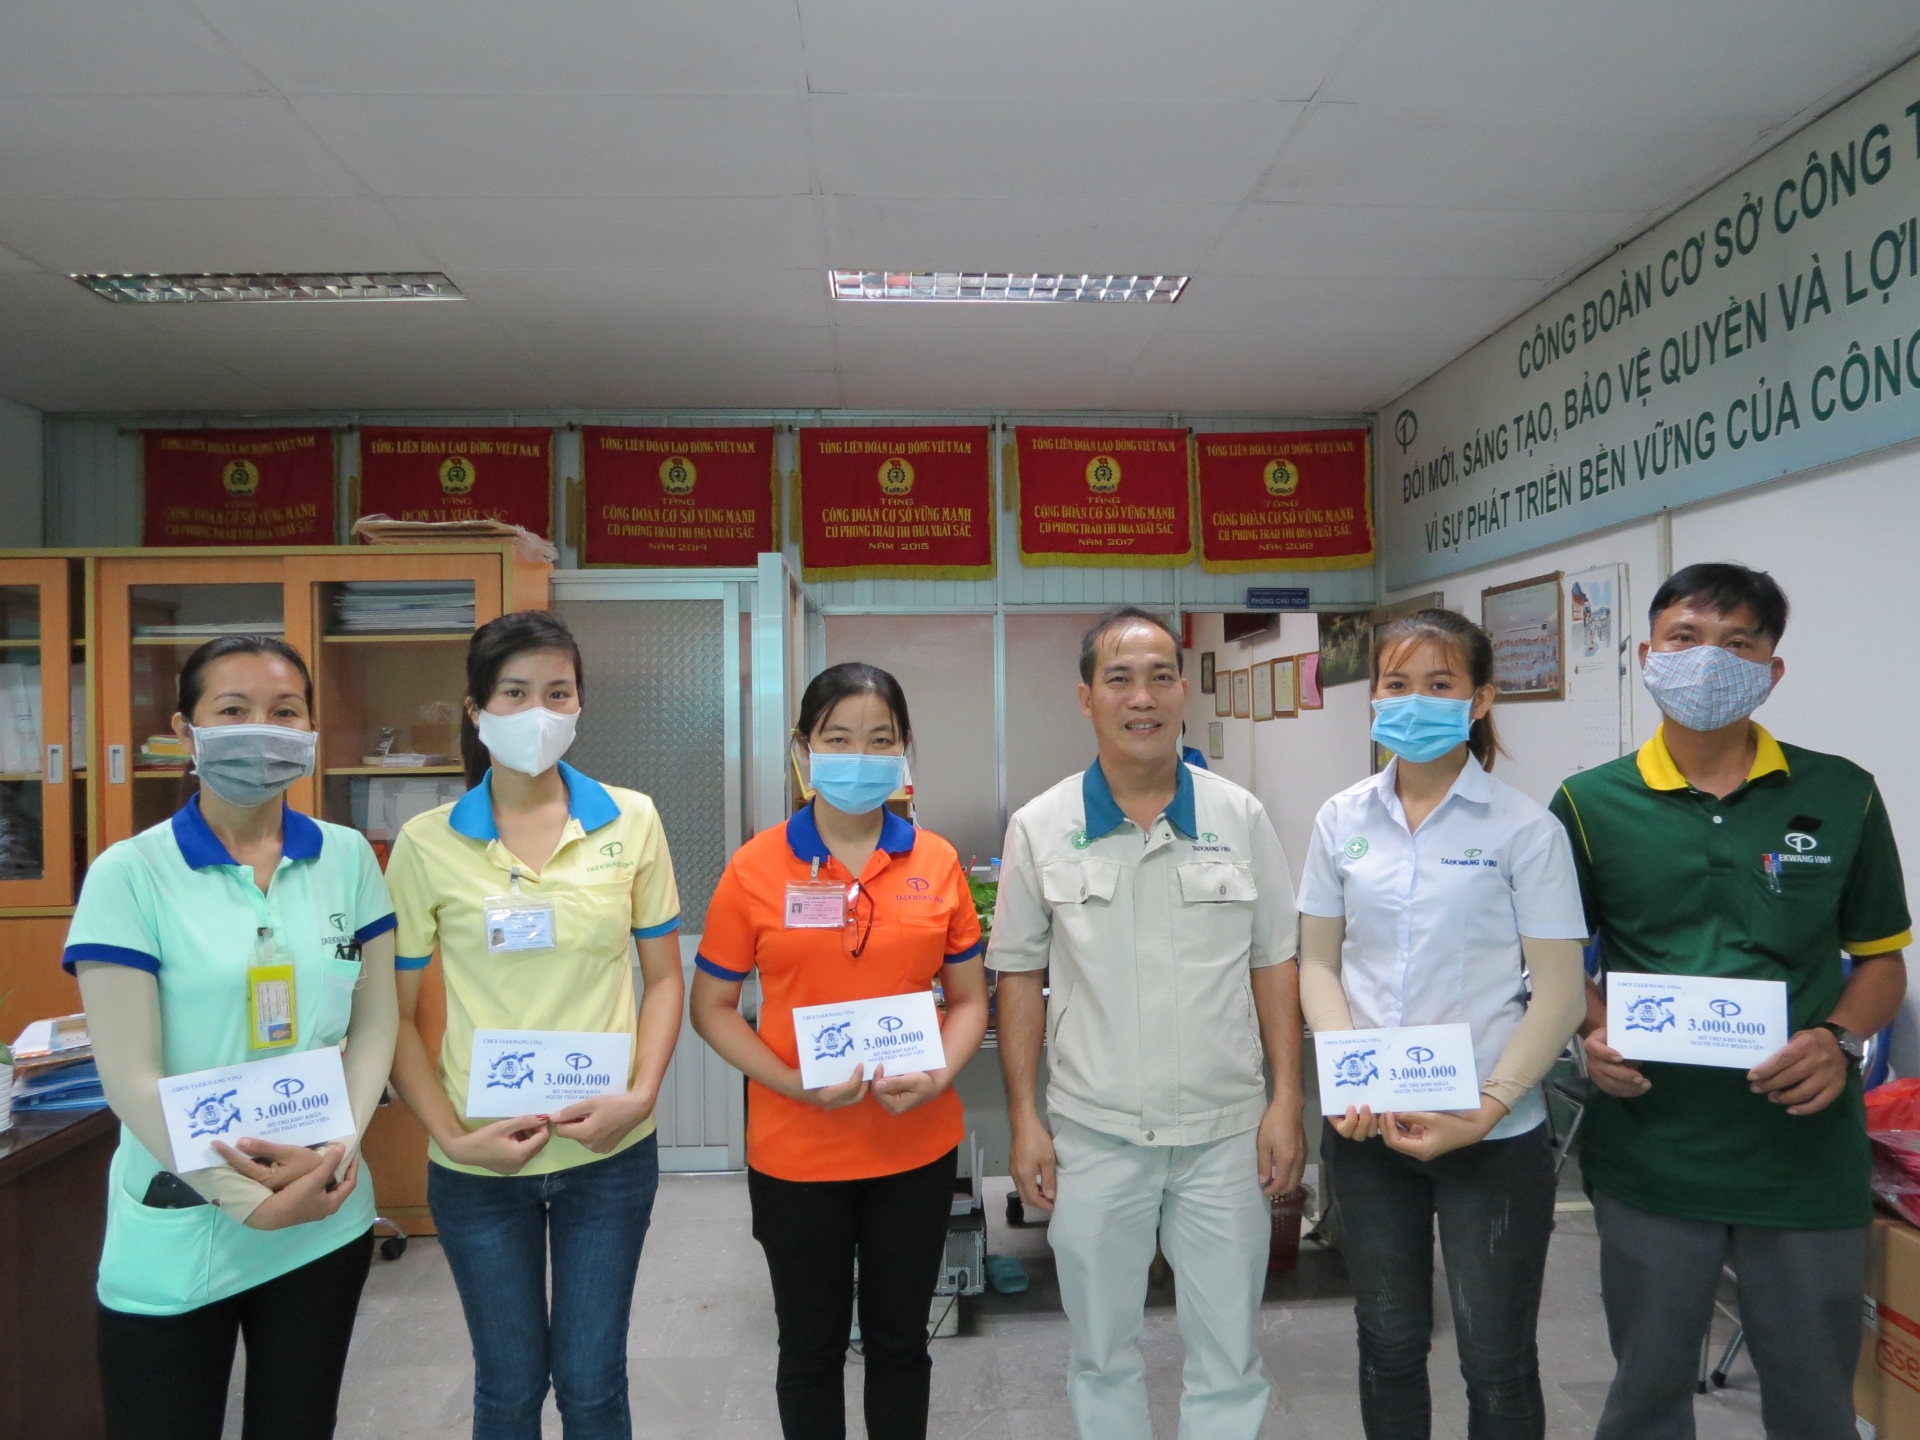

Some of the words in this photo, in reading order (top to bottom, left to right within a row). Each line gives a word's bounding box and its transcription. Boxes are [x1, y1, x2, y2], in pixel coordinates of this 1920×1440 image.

[1518, 313, 1576, 379] CÔNG
[1582, 264, 1651, 344] ĐOÀN
[1661, 231, 1705, 297] CƠ
[1714, 191, 1762, 268] SỞ
[1774, 123, 1891, 234] CÔNG
[1428, 445, 1458, 493] MỚI,
[1463, 428, 1507, 476] SÁNG
[1513, 401, 1557, 457] TẠO,
[1564, 371, 1612, 431] BẢO
[1618, 346, 1651, 407] VỆ
[1660, 292, 1767, 385] QUYỀN
[1777, 252, 1831, 332] VÀ
[1845, 216, 1918, 306] LỢI
[736, 441, 755, 453] NAM
[953, 441, 971, 454] NAM
[1158, 441, 1175, 452] NAM
[1425, 511, 1438, 553] VÌ
[1442, 510, 1463, 553] SỰ
[1467, 487, 1510, 540] PHÁT
[1515, 463, 1571, 523] TRIỂN
[1579, 443, 1625, 502] BỀN
[1633, 411, 1715, 481] VỮNG
[1726, 376, 1800, 450] CỦA
[1107, 538, 1135, 546] 2017
[1779, 854, 1814, 863] EKWANG
[1814, 856, 1831, 864] VINA
[1687, 1018, 1765, 1036] 3.000.000
[863, 1030, 924, 1051] 3.000.000
[544, 1073, 610, 1086] 3.000.000
[1389, 1065, 1457, 1081] 3.000.000
[254, 1092, 329, 1122] 3.000.000
